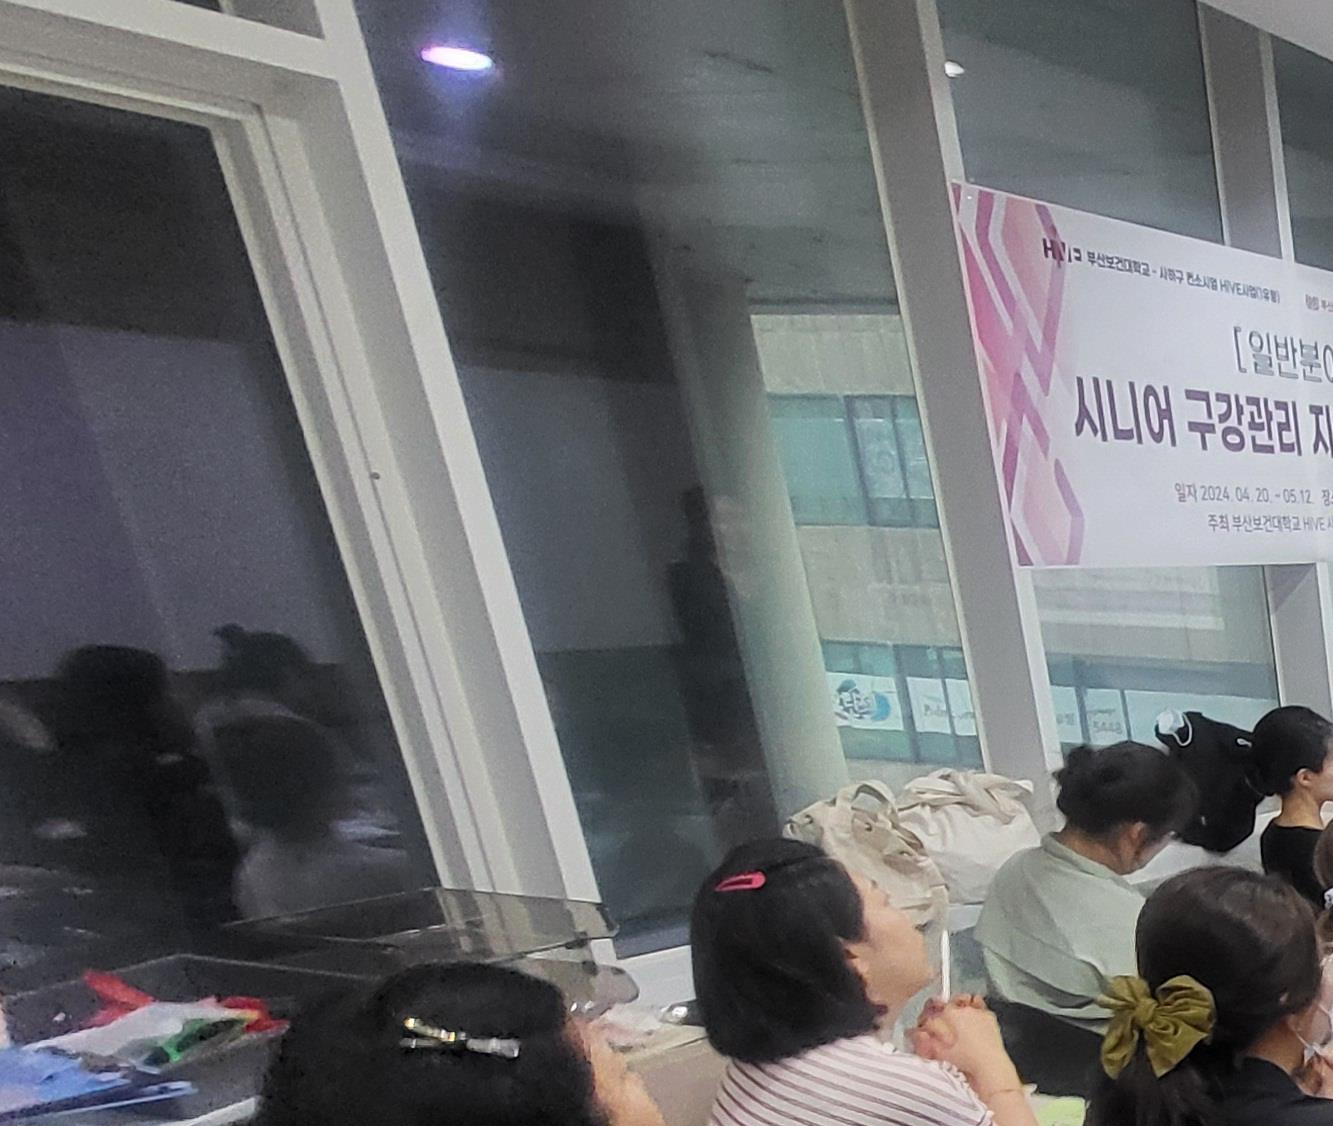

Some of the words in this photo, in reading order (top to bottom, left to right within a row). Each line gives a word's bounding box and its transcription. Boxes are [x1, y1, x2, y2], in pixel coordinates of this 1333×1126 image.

[1087, 250, 1151, 277] 부산보건대학교
[1075, 376, 1177, 447] 시니어
[1184, 388, 1303, 457] 구강관리
[1174, 482, 1198, 504] 일자
[1208, 513, 1230, 533] 주최
[1232, 513, 1301, 534] 부산보건대학교
